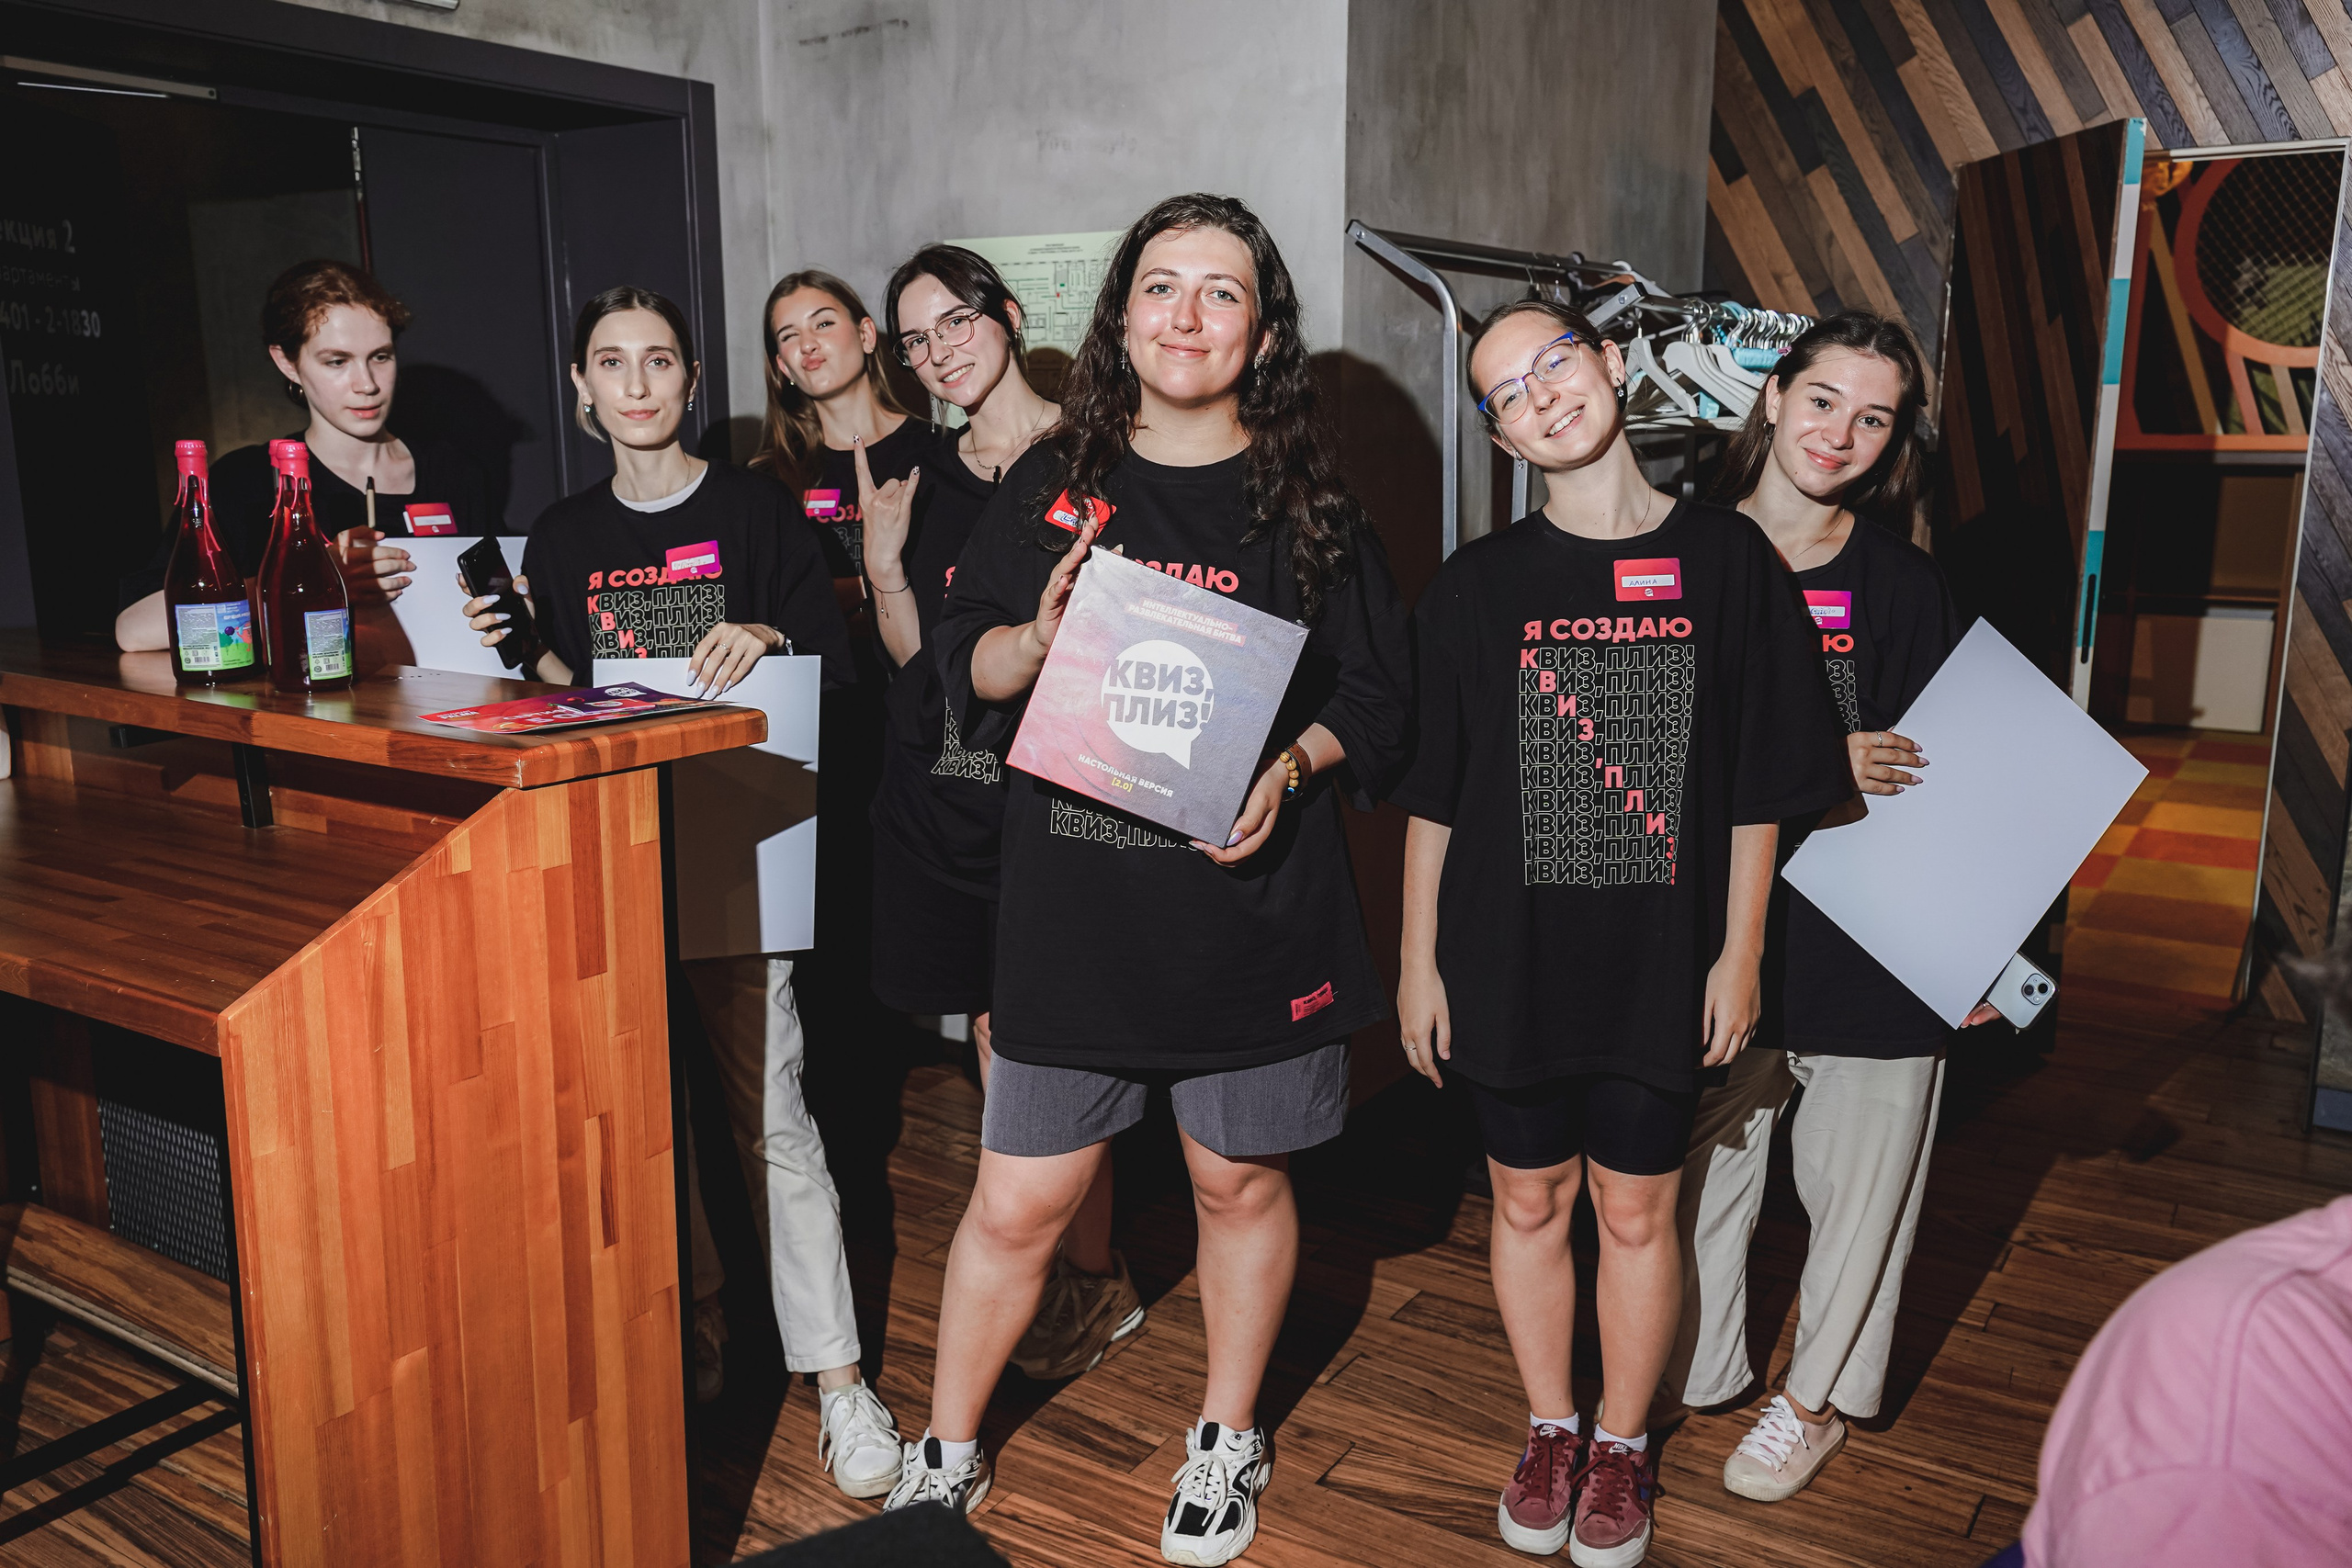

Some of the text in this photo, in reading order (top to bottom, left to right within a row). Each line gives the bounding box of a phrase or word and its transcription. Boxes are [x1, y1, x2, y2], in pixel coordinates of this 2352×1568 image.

[0, 219, 76, 254] кция 2
[10, 359, 80, 396] Лобби
[588, 571, 603, 591] Я
[1128, 604, 1242, 644] РАЗВЛЕКАТЕЛЬНАЯ БИТВА
[1142, 600, 1233, 631] ИНТЕЛЛЕКТУАЛЬНО-
[1522, 617, 1693, 643] Я СОЗДАЮ
[1108, 659, 1214, 703] КВИЗ,
[1102, 693, 1211, 731] ПЛИЗ!
[1078, 754, 1174, 798] НАСТОЛЬНАЯ ВЕРСИЯ
[1111, 777, 1134, 793] [2.0]
[1613, 1442, 1628, 1450] NIKE
